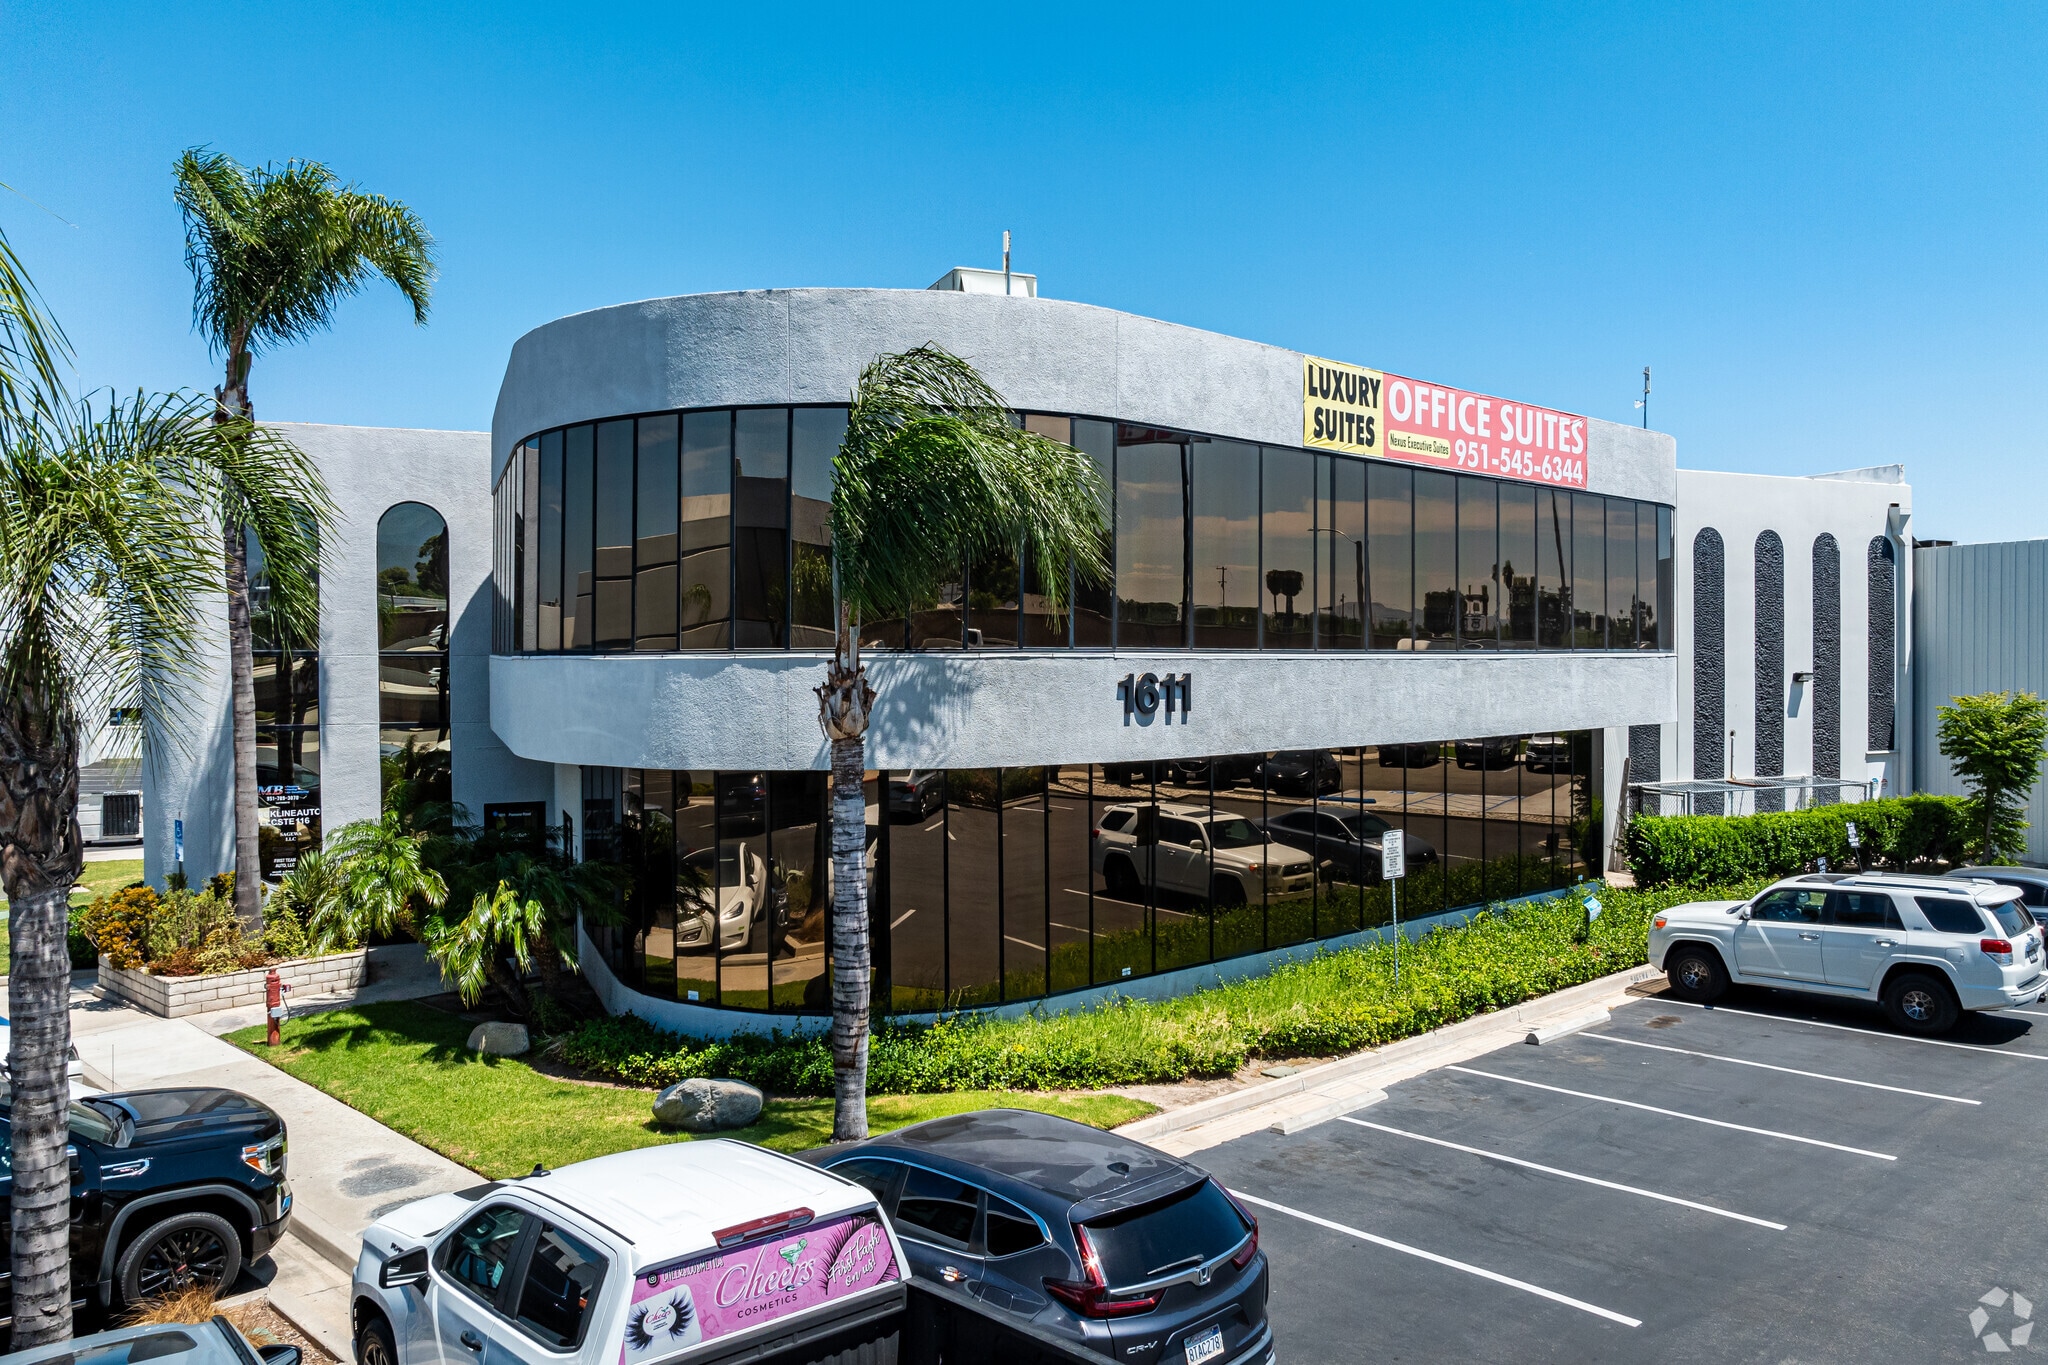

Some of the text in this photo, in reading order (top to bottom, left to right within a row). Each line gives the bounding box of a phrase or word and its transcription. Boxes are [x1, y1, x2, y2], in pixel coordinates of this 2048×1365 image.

[1308, 364, 1381, 409] LUXURY
[1313, 406, 1375, 448] SUITES
[1388, 381, 1585, 455] OFFICE SUITES
[1389, 433, 1449, 455] Nexus Executive Suites
[1454, 439, 1584, 484] 951-545-6344
[1117, 672, 1192, 715] 1611
[296, 816, 310, 824] 116
[715, 1234, 816, 1309] Cheers
[846, 1271, 862, 1287] on
[737, 1293, 798, 1319] COSMETICS
[1127, 1340, 1158, 1355] CR-V
